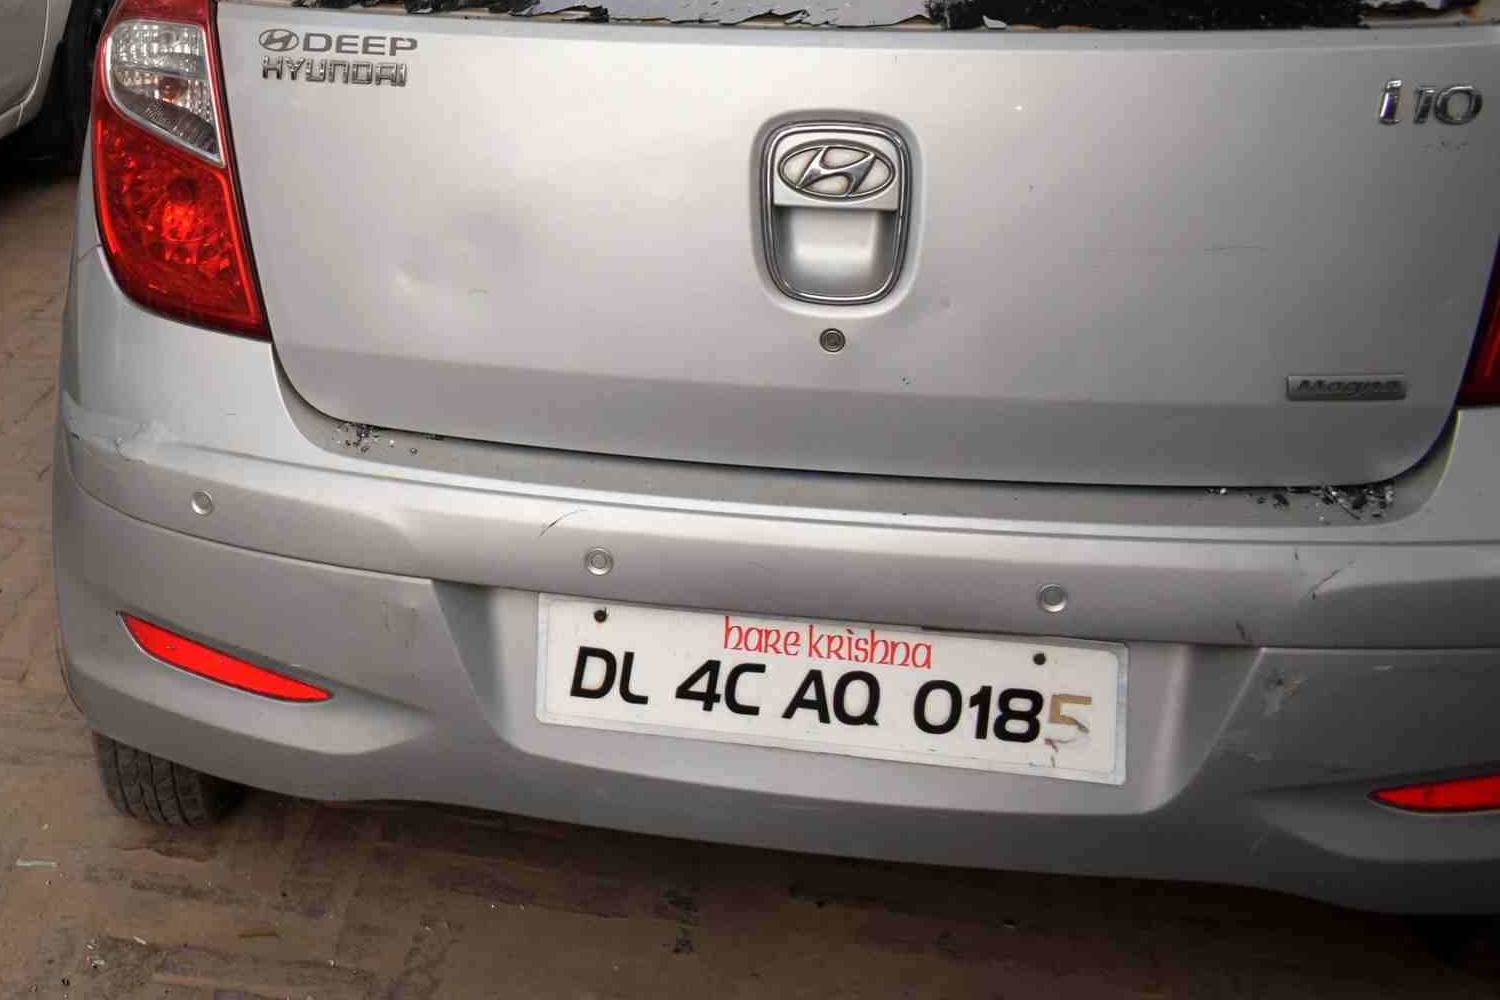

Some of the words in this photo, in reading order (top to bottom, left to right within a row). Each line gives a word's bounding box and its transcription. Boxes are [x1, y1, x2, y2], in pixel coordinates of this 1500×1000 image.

[302, 32, 418, 56] DEEP
[261, 55, 408, 88] HYUNDAI
[723, 615, 800, 657] hare
[808, 624, 932, 670] krishna
[570, 646, 649, 705] DL
[675, 659, 766, 716] 4C
[781, 668, 880, 727] AQ
